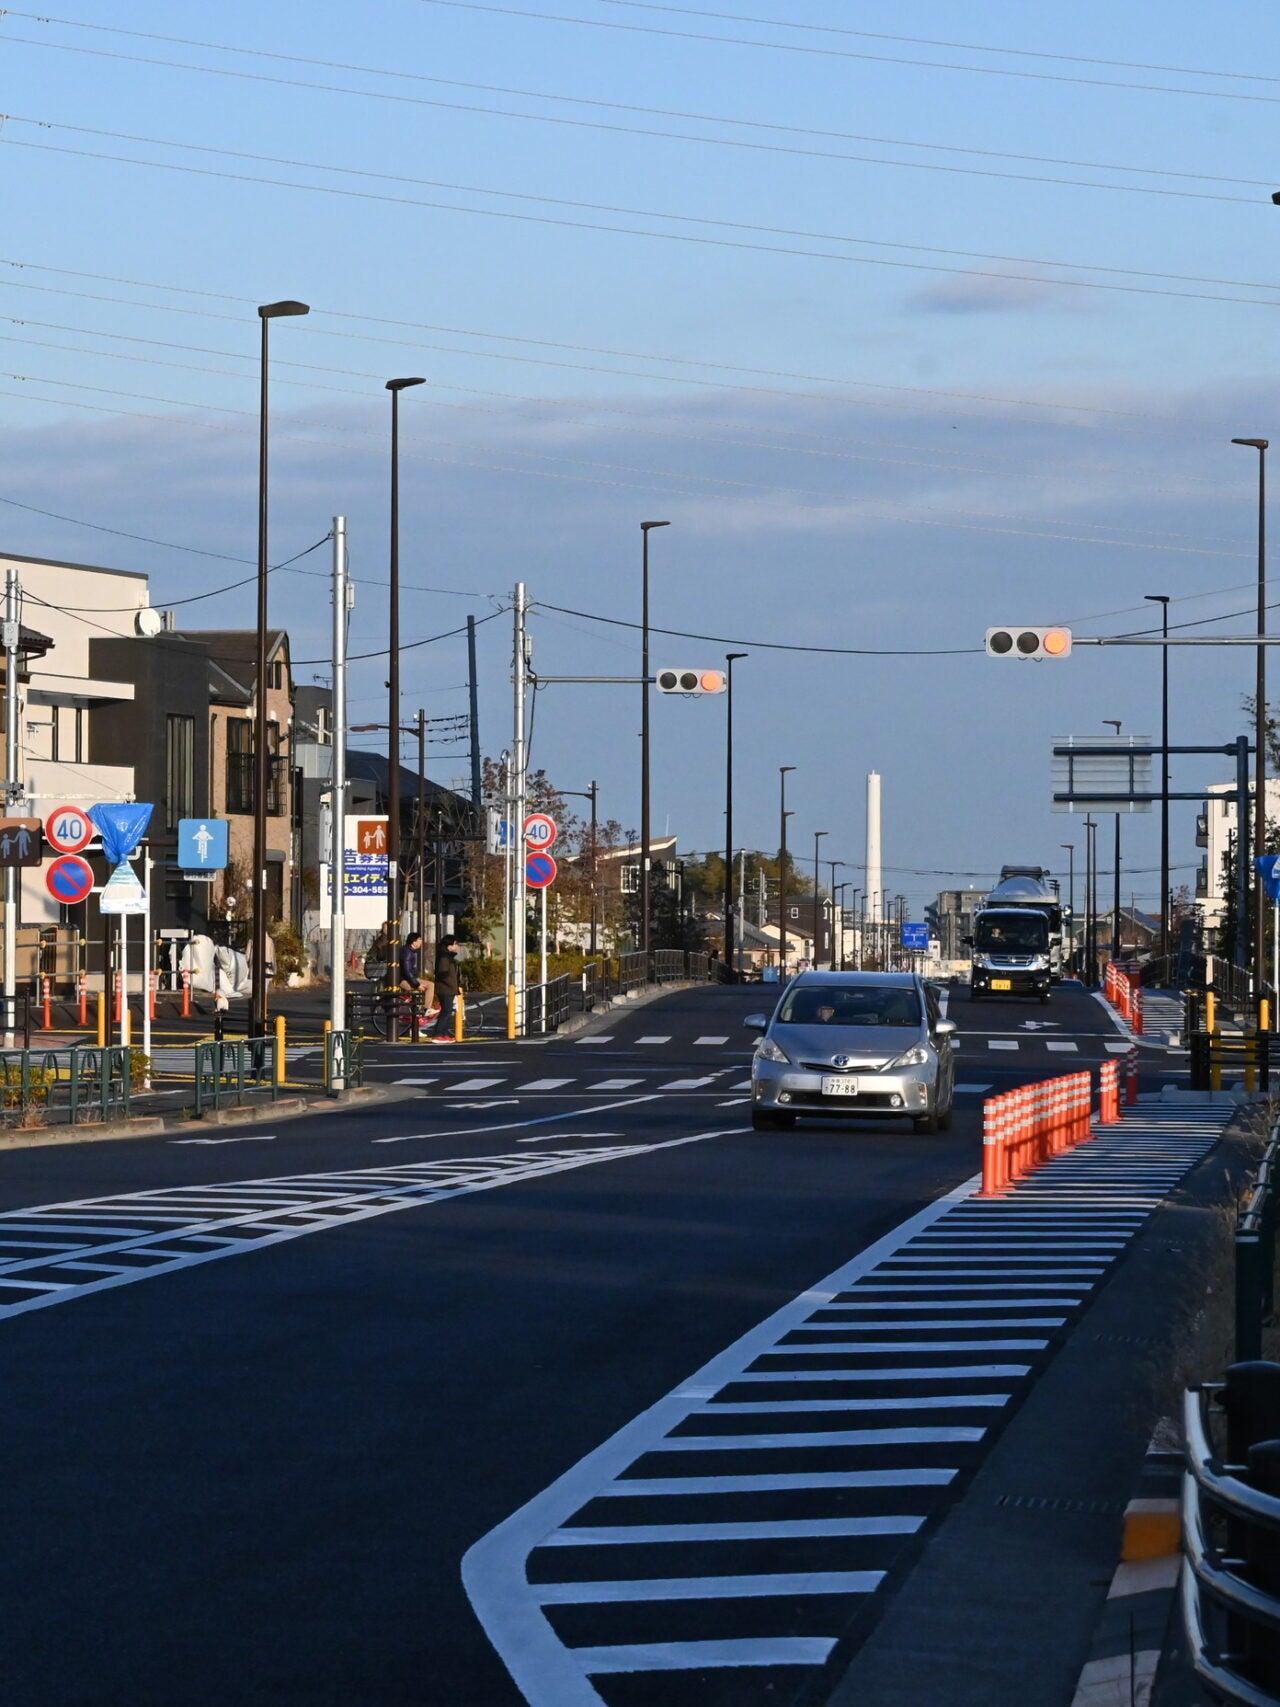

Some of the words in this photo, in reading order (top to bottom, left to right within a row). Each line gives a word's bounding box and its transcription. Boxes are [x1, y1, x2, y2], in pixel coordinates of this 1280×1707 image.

[57, 818, 82, 840] 40
[529, 824, 548, 840] 40
[328, 886, 388, 894] 00-304-555
[829, 1083, 856, 1094] 77-88
